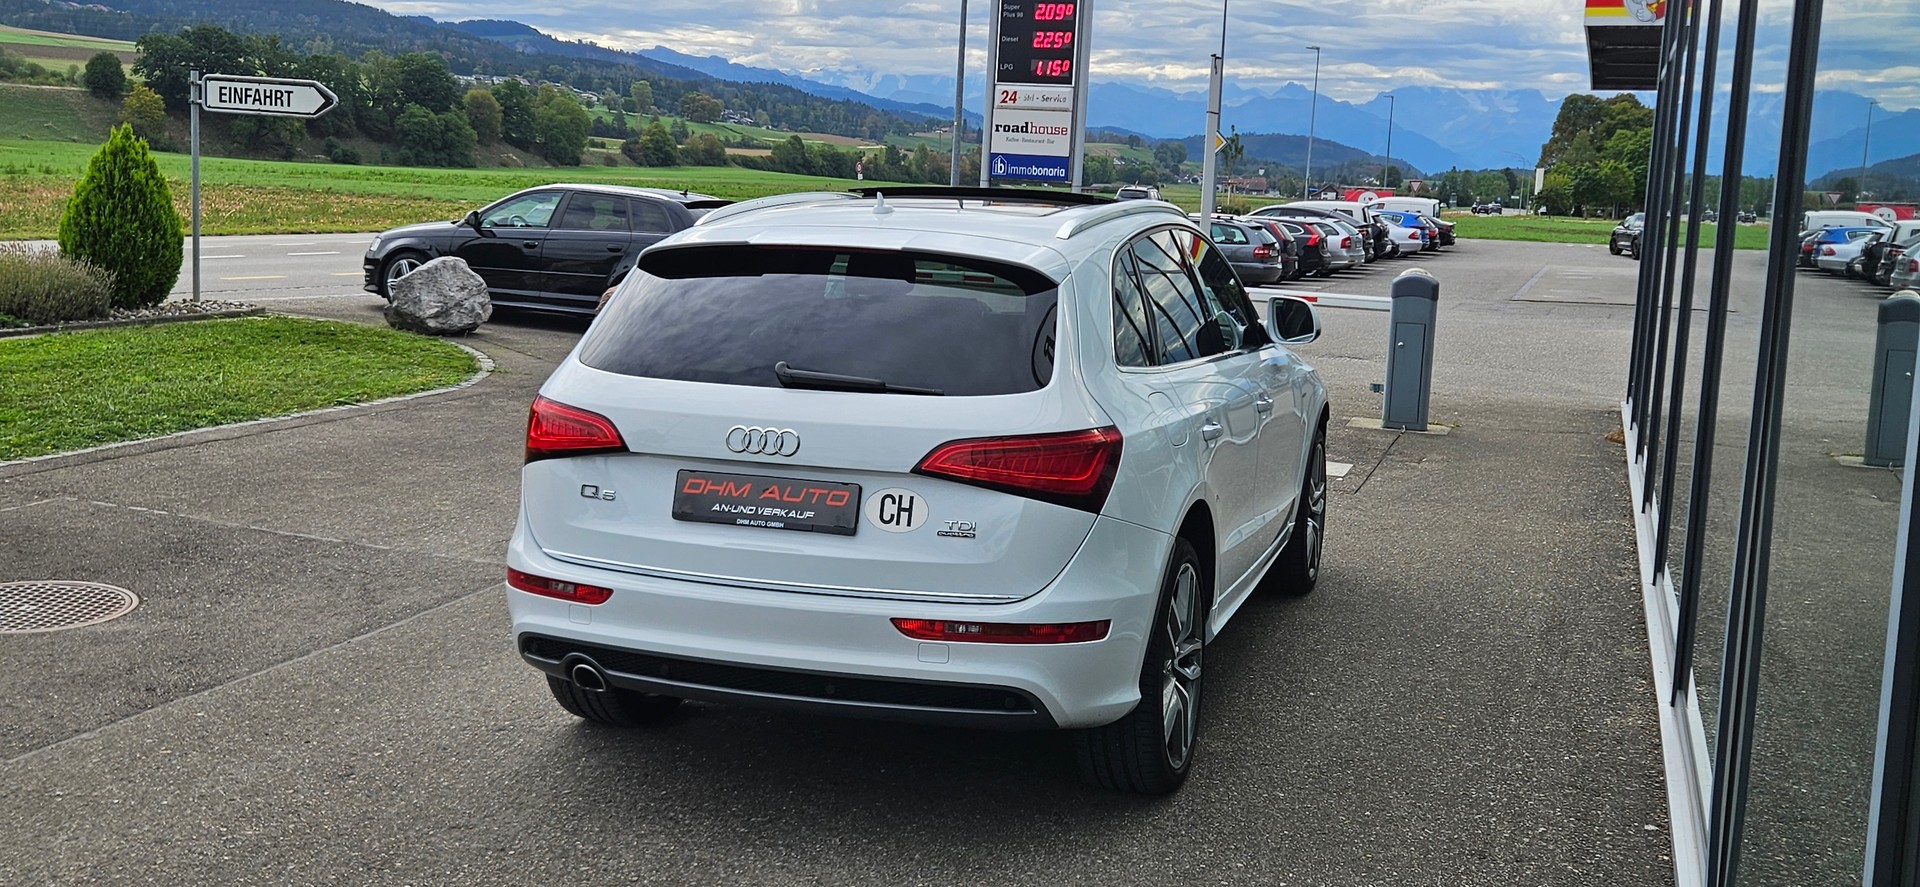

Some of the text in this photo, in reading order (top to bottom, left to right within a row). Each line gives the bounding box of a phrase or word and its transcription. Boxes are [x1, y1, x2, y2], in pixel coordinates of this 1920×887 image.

[218, 86, 294, 107] EINFAHRT
[1000, 90, 1018, 104] 24
[1041, 94, 1067, 103] Service
[994, 122, 1068, 136] roadhouse
[1007, 164, 1066, 177] immobonaria
[580, 483, 617, 502] Q5
[682, 477, 852, 507] DHM AUTO
[711, 503, 815, 519] AN-UND VERKAUF
[879, 493, 914, 527] CH
[750, 519, 766, 527] AUTO
[944, 520, 977, 532] TDI
